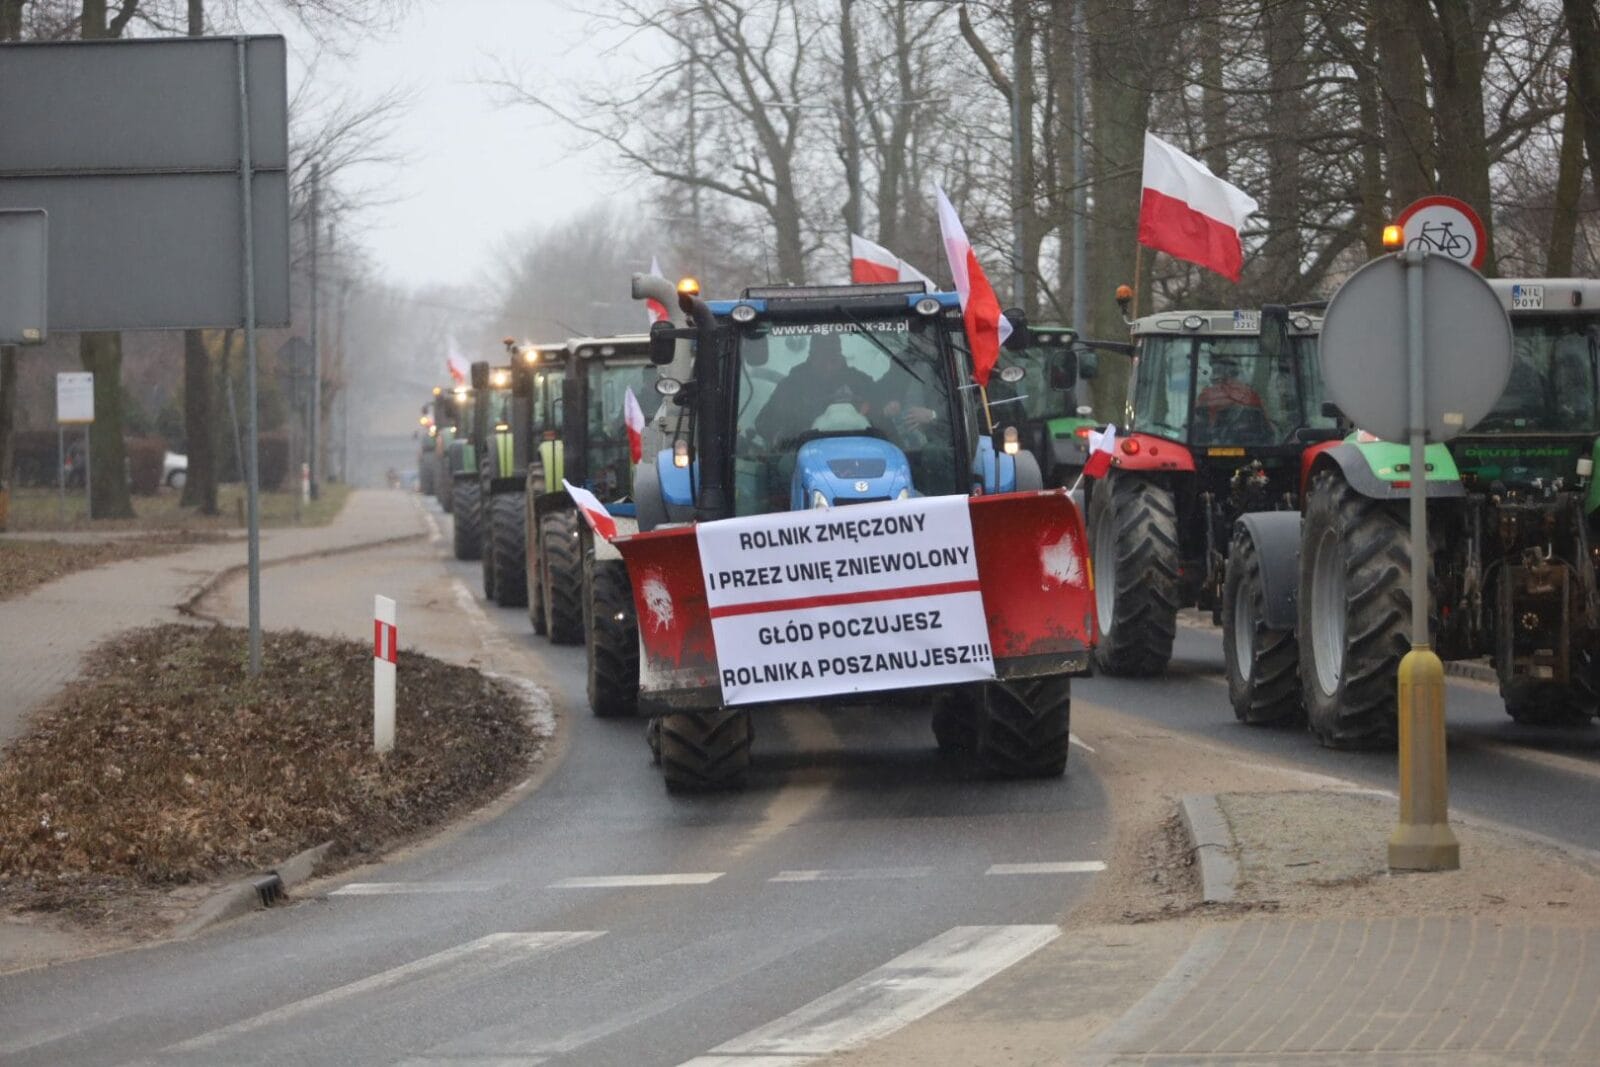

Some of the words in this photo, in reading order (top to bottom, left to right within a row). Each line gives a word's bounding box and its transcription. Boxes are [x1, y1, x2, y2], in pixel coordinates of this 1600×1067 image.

[1521, 287, 1540, 297] NIL
[772, 319, 909, 335] www.agromx-az.pl
[739, 526, 814, 550] ROLNIK
[816, 513, 926, 543] ZMĘCZONY
[709, 573, 716, 590] I
[719, 566, 783, 589] PRZEZ
[786, 561, 833, 583] UNIĘ
[836, 546, 970, 577] ZNIEWOLONY
[758, 620, 814, 645] GŁÓD
[819, 610, 942, 639] POCZUJESZ
[722, 660, 814, 688] ROLNIKA
[819, 643, 991, 677] POSZANUJESZ!!!
